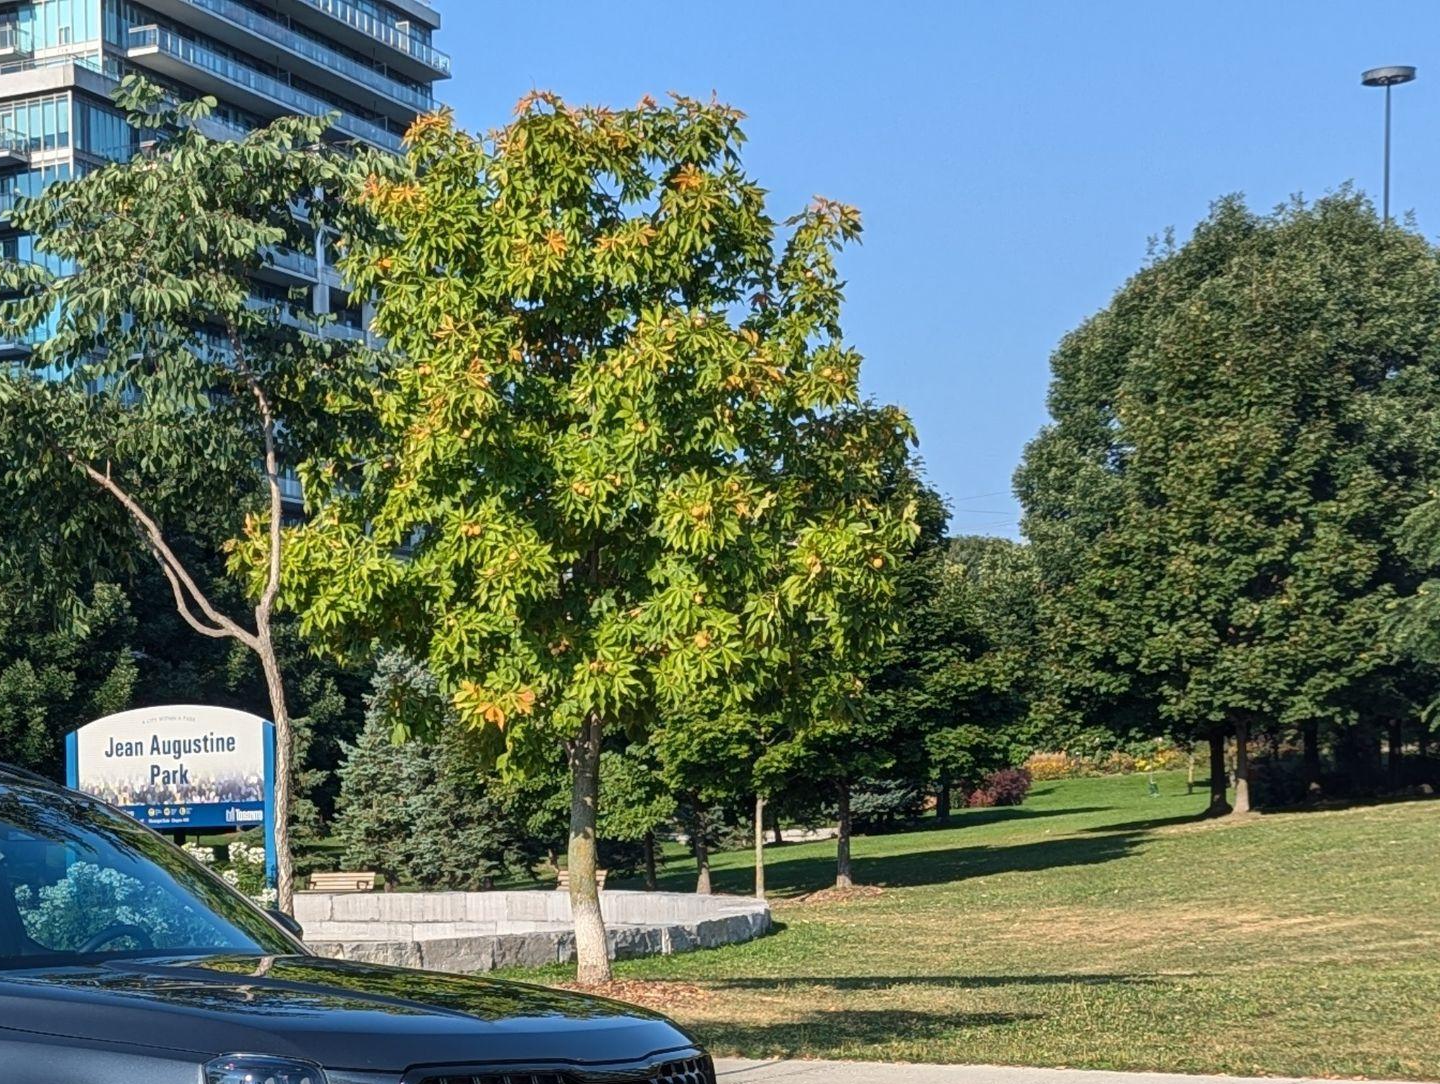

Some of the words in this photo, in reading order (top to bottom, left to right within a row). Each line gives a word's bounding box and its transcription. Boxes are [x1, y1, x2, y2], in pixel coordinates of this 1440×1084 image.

[105, 737, 143, 757] Jean
[150, 732, 235, 759] Augustine
[150, 764, 188, 785] Park
